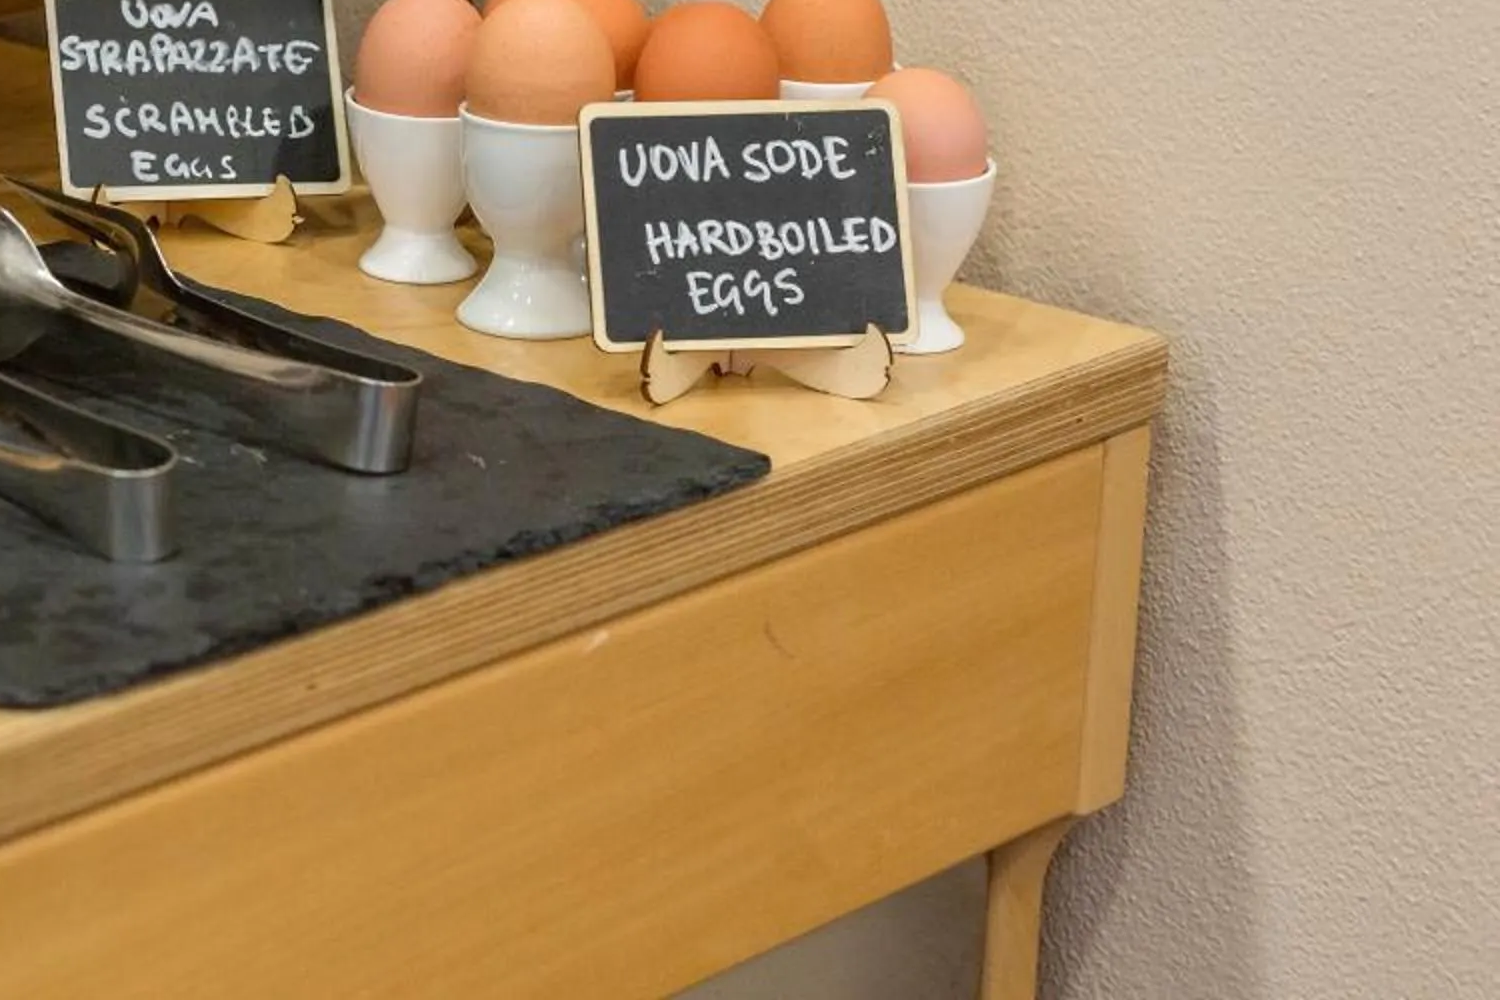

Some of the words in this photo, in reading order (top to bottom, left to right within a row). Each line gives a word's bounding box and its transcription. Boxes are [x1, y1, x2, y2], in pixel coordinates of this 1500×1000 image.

[59, 32, 322, 76] STRAPAZZATE
[83, 101, 316, 140] SCRAMBLED
[129, 150, 238, 183] EGGS
[618, 135, 732, 188] UOVA
[741, 135, 857, 183] SODE
[644, 215, 898, 265] HARDBOILED
[685, 266, 805, 316] EGGS
